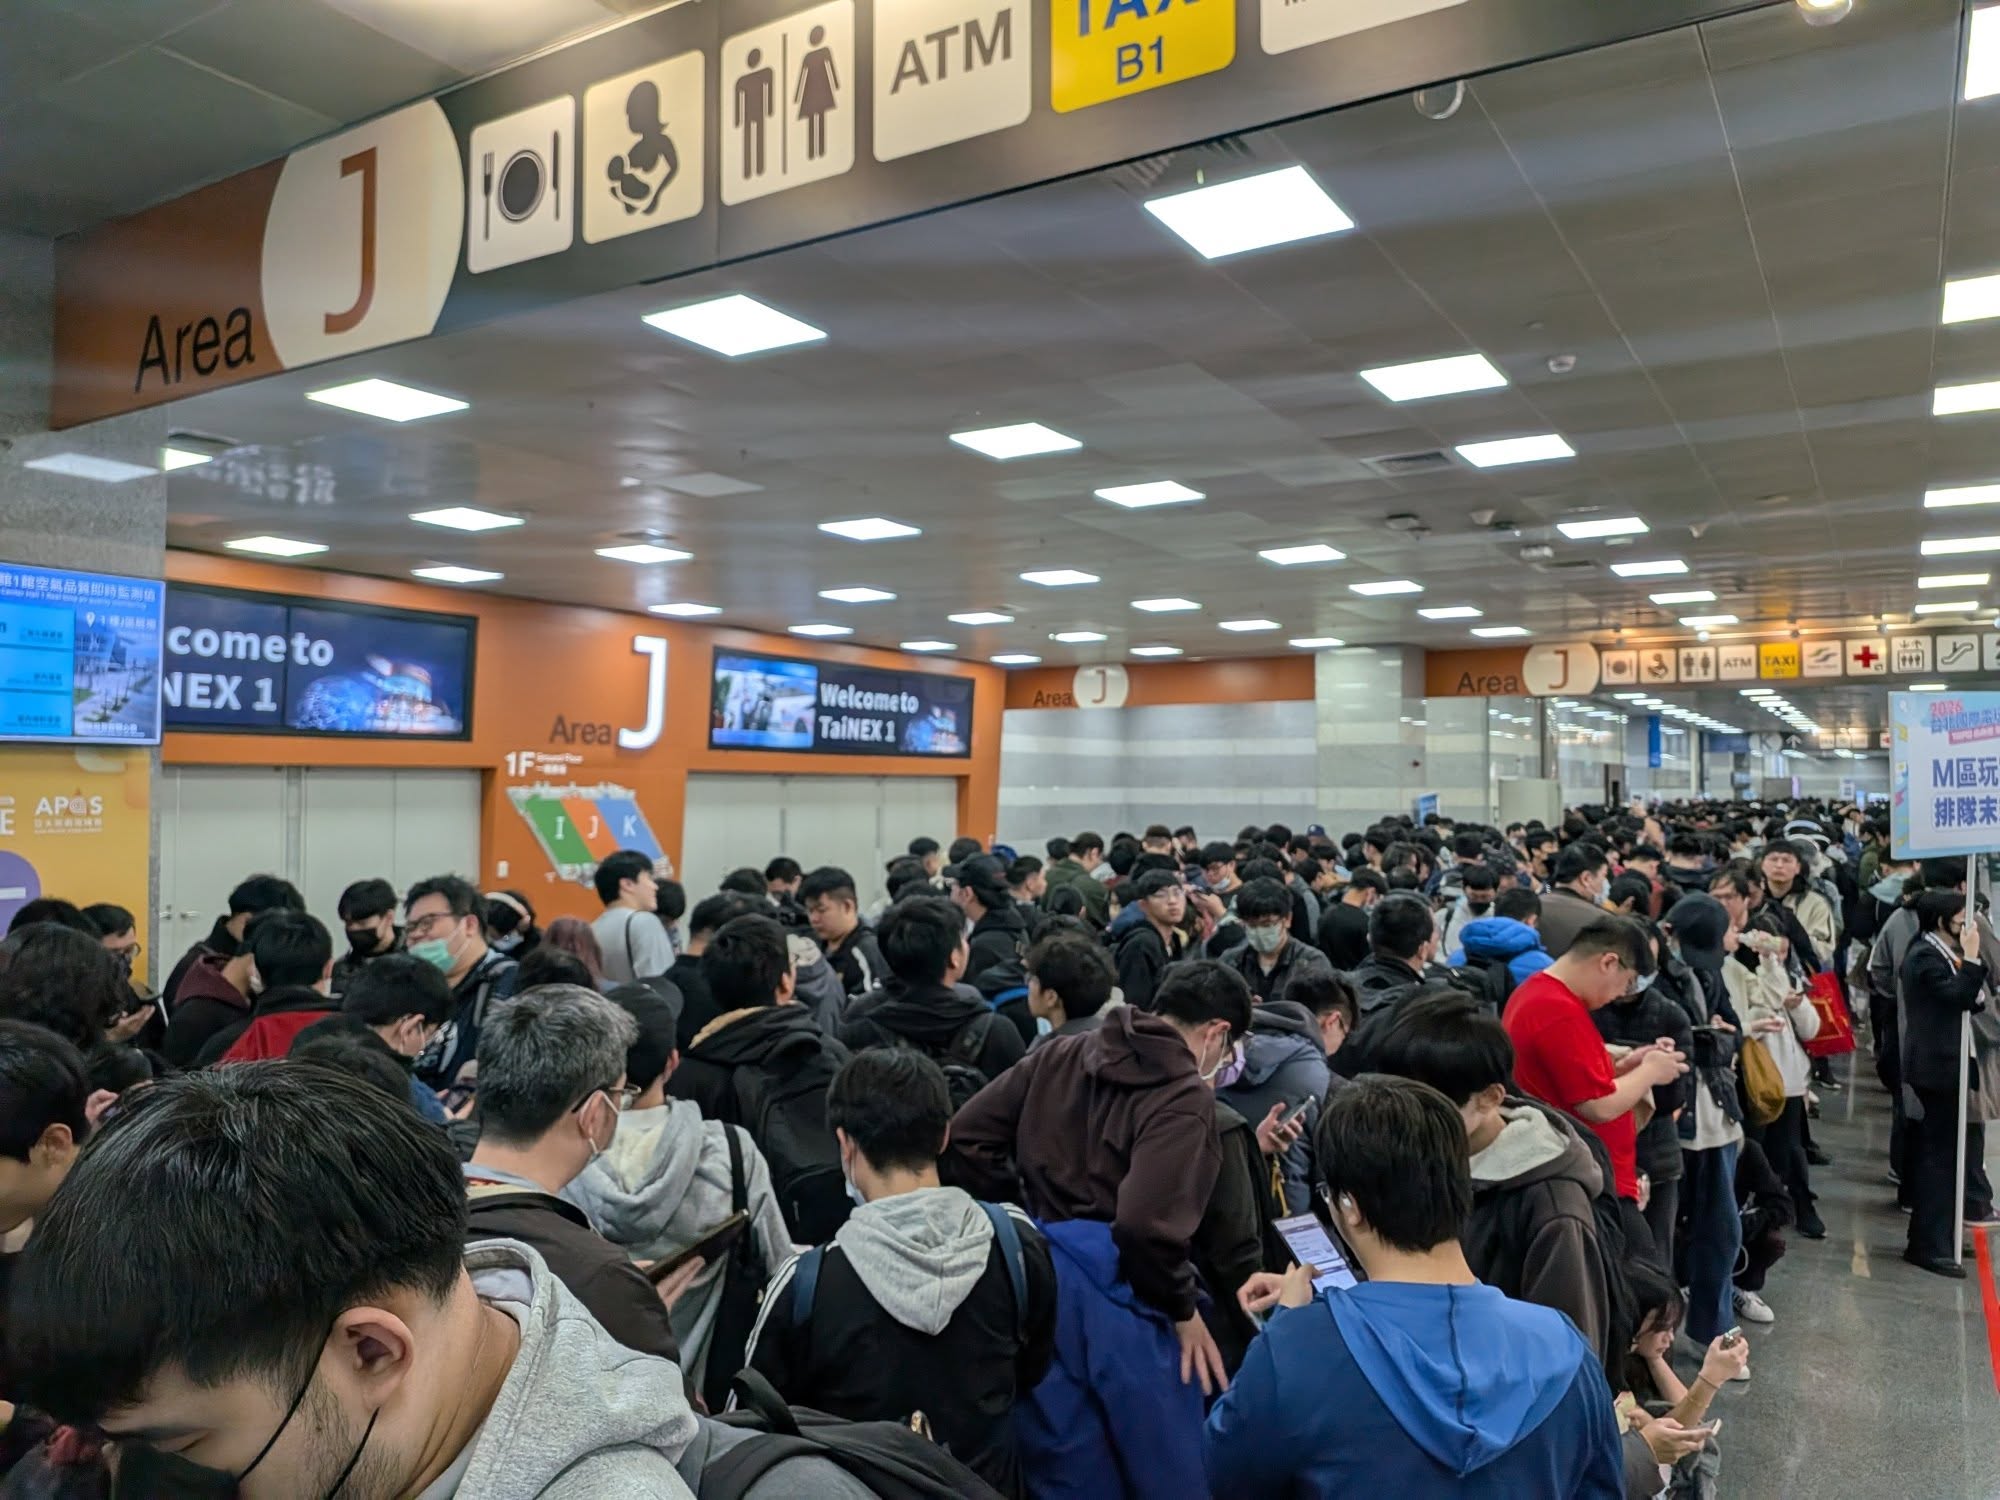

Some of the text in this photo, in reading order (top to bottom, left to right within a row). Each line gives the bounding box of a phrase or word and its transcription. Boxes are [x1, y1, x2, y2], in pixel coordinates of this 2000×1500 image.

[889, 8, 1012, 96] ATM
[1116, 35, 1163, 84] B1
[134, 146, 378, 394] Area J
[290, 632, 334, 667] to
[1723, 656, 1753, 668] ATM
[1763, 654, 1796, 667] TAXI
[1033, 668, 1107, 707] Area J
[1456, 650, 1569, 694] Area J
[252, 677, 277, 712] 1
[549, 634, 668, 751] Area J
[820, 682, 920, 714] Welcome to
[818, 715, 896, 743] TaiNEX 1
[503, 751, 536, 778] 1F
[554, 814, 638, 840] I J K
